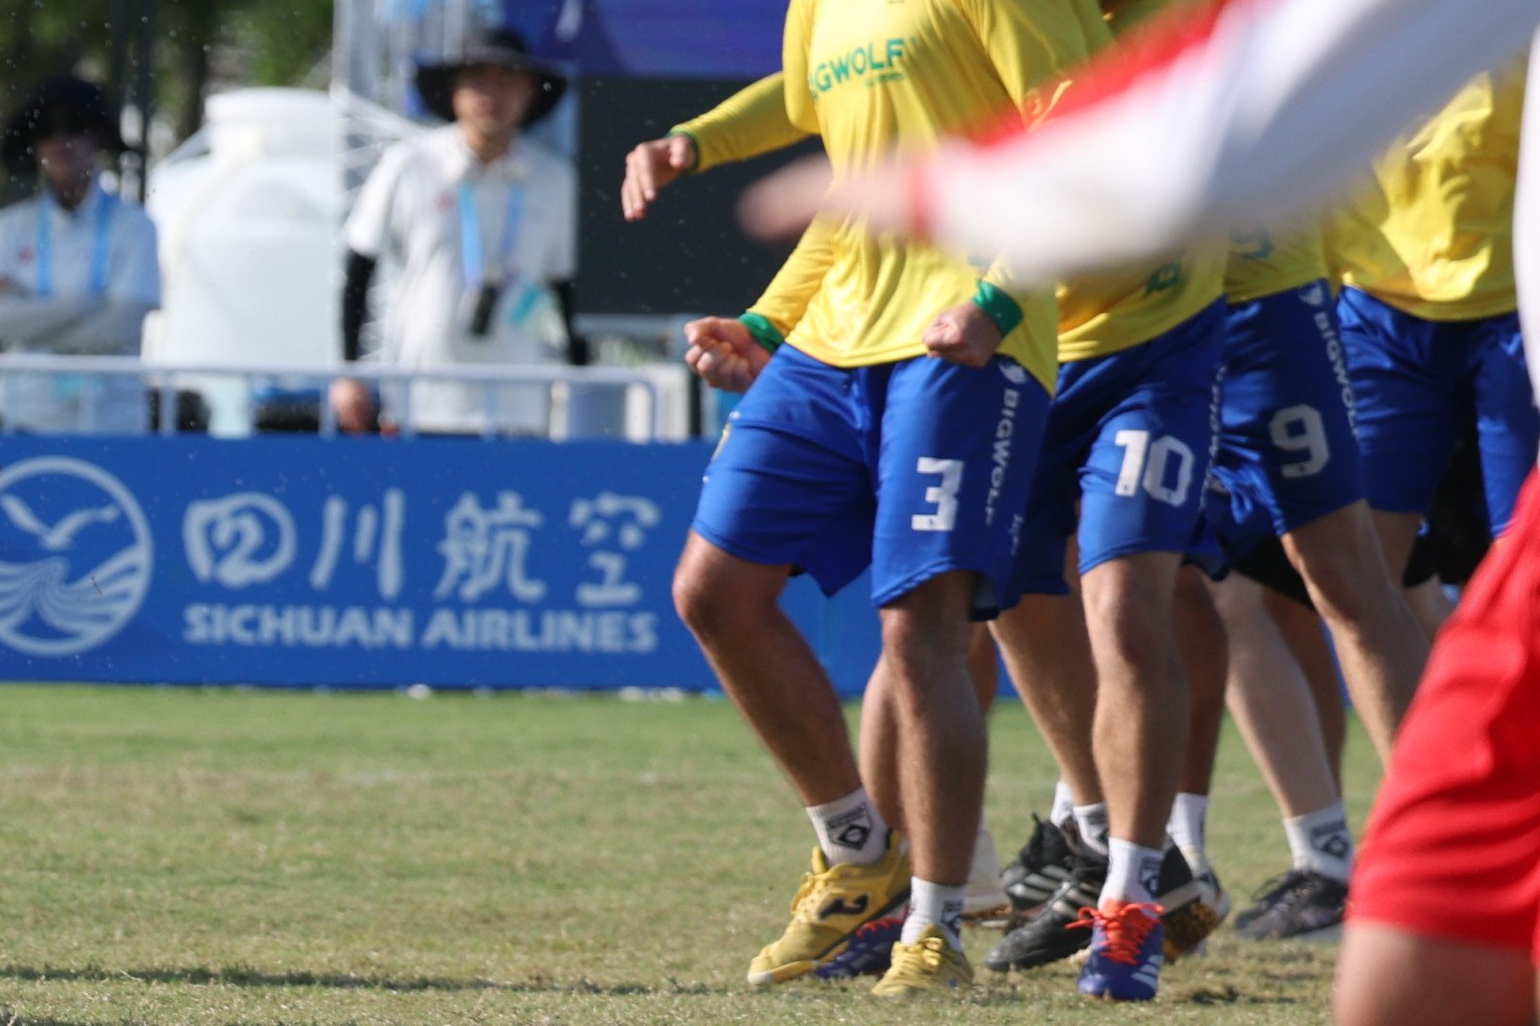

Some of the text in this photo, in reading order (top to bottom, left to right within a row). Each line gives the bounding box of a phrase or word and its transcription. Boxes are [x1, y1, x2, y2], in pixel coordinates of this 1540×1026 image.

[985, 388, 1020, 526] BIGWOLF
[1113, 429, 1196, 508] 10
[1268, 403, 1330, 479] 9
[911, 456, 965, 532] 3
[182, 488, 661, 607] 四川航空
[183, 602, 659, 654] SICHUAN AIRLINES
